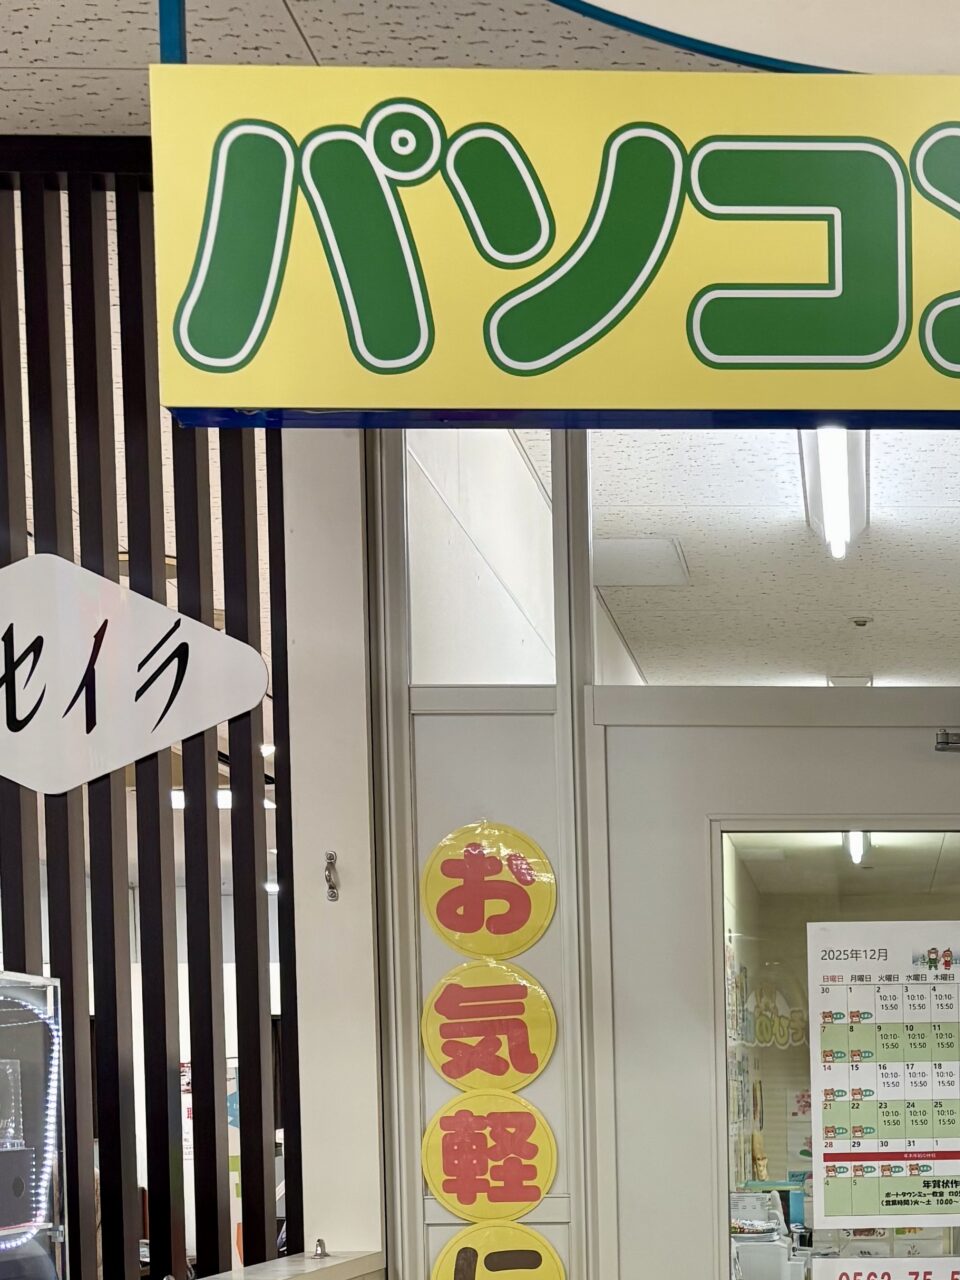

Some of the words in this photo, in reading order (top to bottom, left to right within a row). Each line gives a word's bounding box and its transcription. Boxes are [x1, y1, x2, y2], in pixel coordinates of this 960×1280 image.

[0, 617, 190, 734] セイラ
[820, 949, 888, 961] 2025年12月
[823, 975, 844, 983] 日曜日
[850, 974, 872, 982] 月曜日
[878, 974, 900, 982] 火曜日
[906, 974, 927, 982] 水曜日
[933, 973, 955, 981] 木曜日
